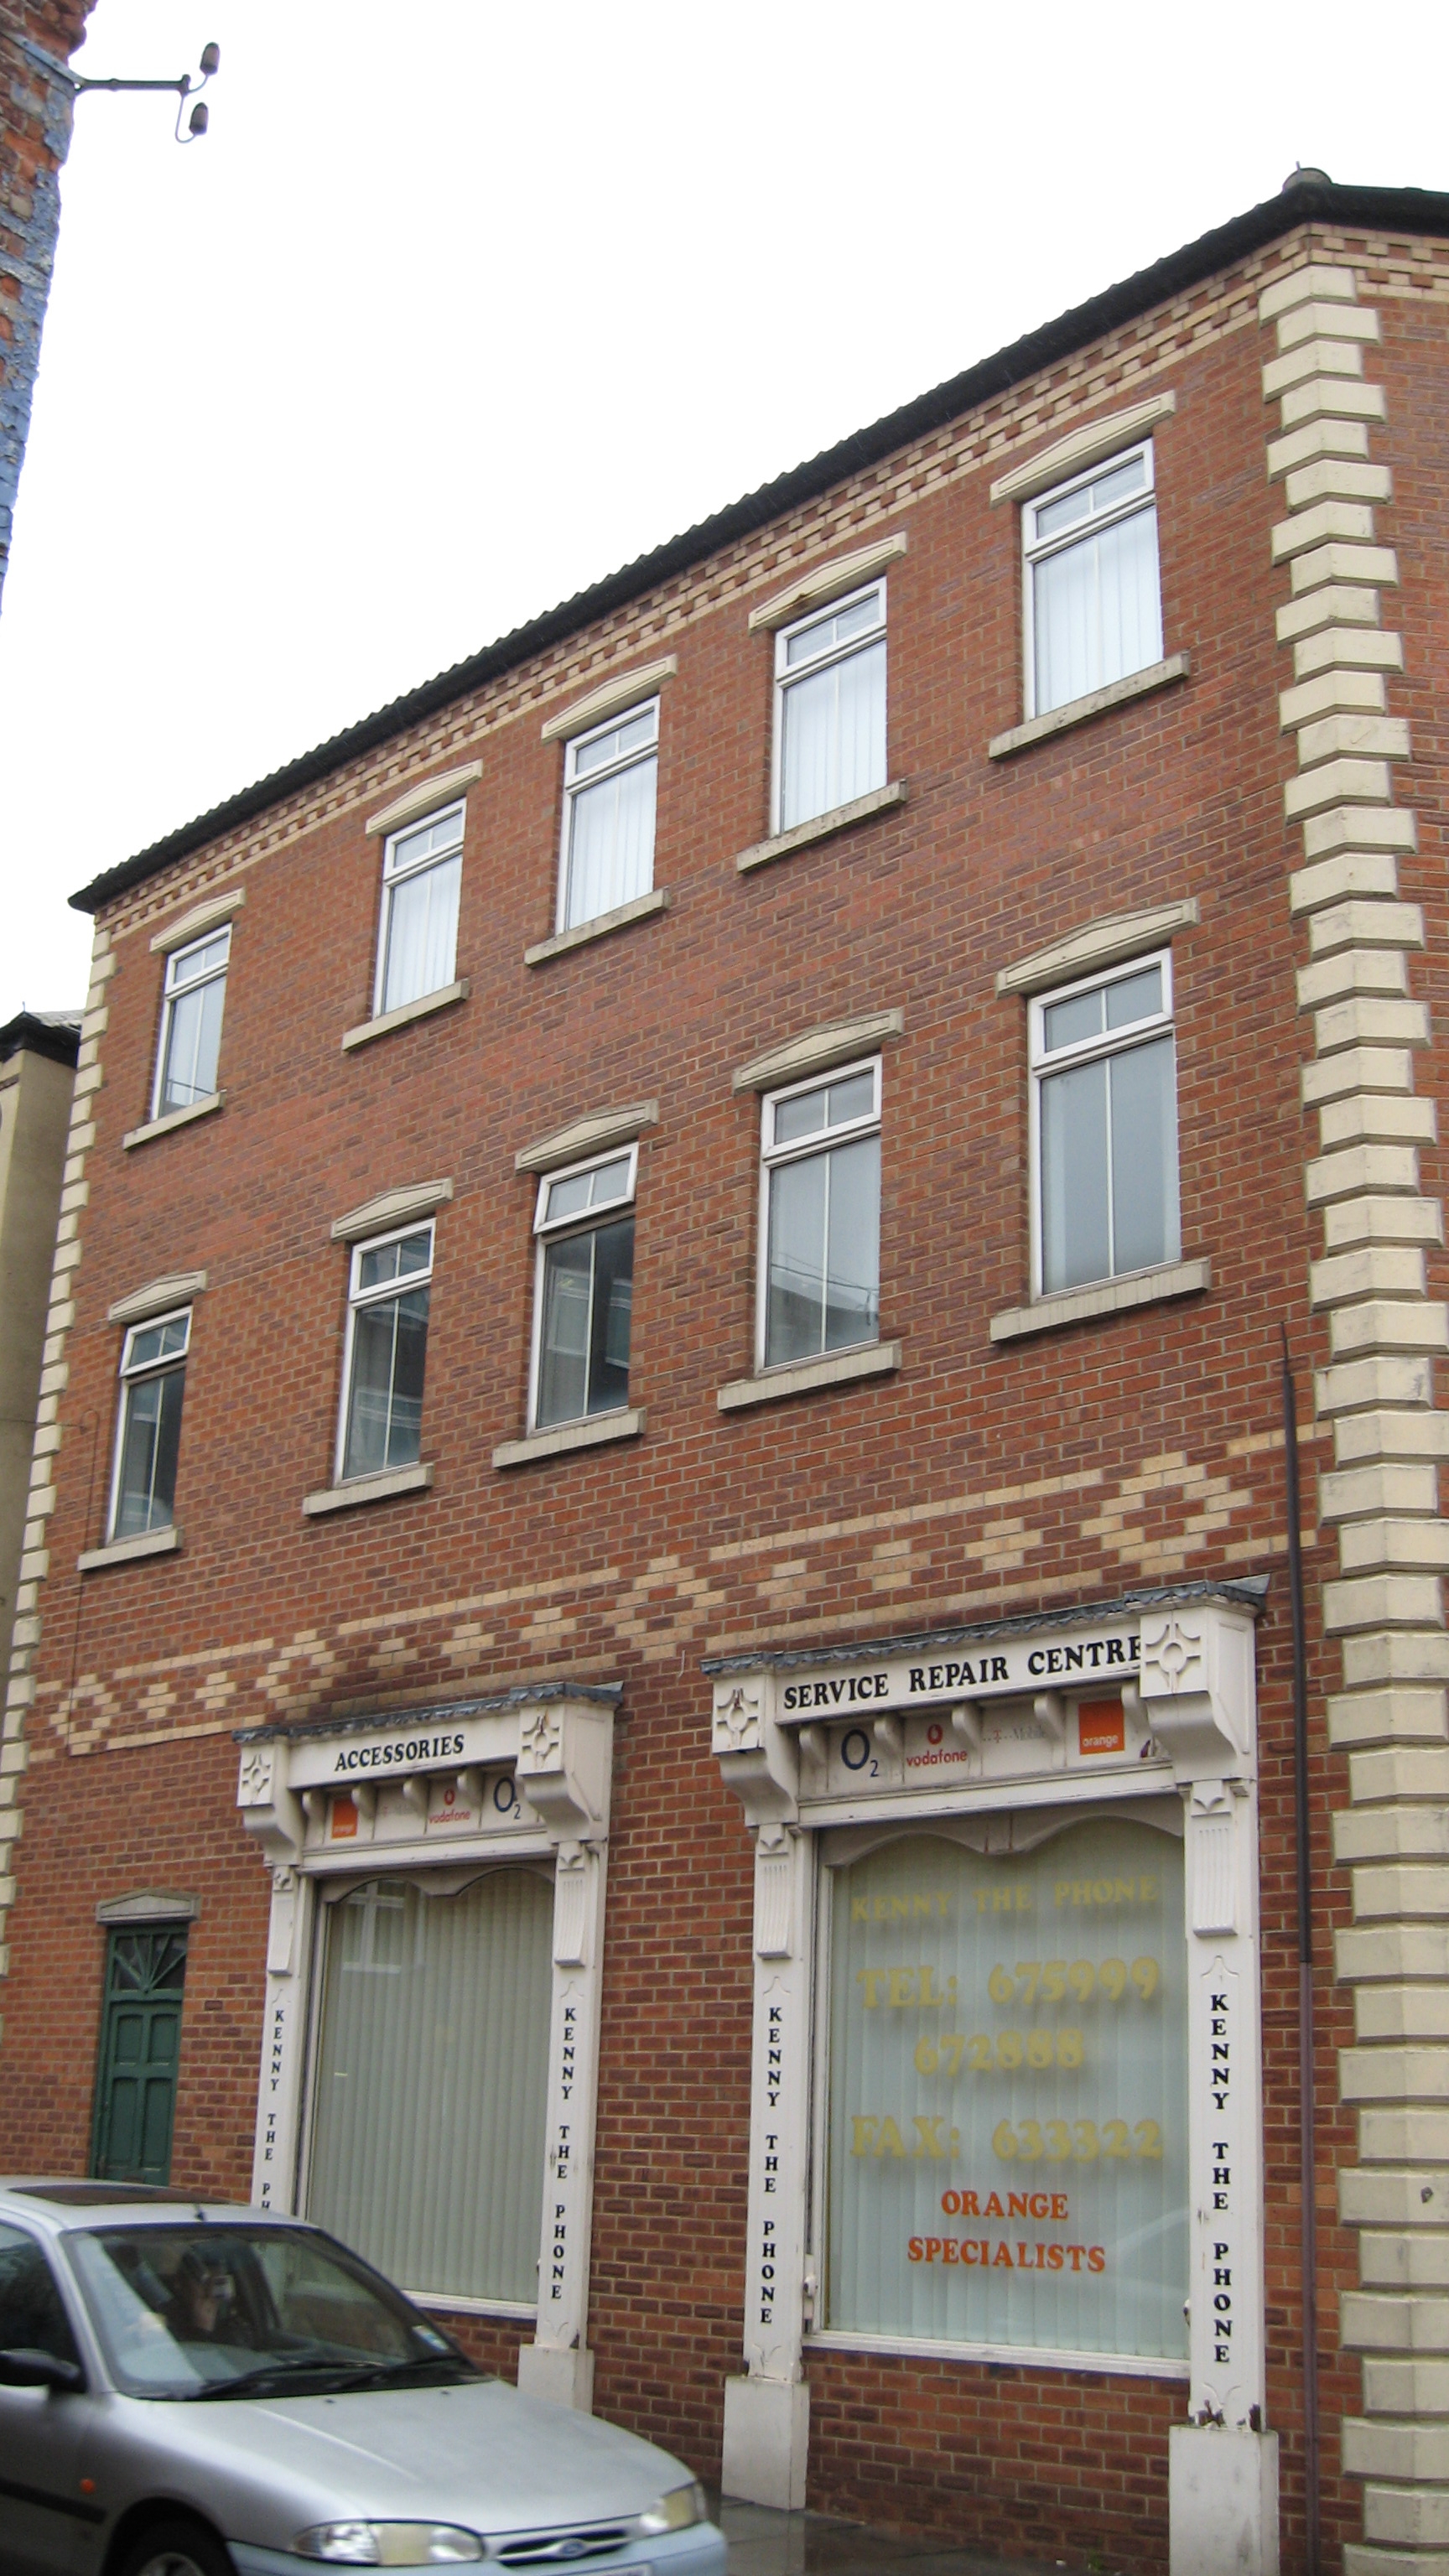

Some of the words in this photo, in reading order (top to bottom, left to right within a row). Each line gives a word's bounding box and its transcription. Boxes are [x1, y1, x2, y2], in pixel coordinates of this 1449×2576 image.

[784, 1673, 889, 1710] SERVICE
[909, 1656, 1010, 1692] REPAIR
[1028, 1635, 1140, 1675] CENTRE
[335, 1734, 465, 1772] ACCESSORIES
[906, 1748, 968, 1768] vodafone
[1082, 1734, 1119, 1748] orange
[428, 1809, 471, 1825] vodafone
[851, 1890, 953, 1923] KENNY
[972, 1886, 1033, 1914] THE
[1053, 1875, 1159, 1909] PHONE
[855, 1965, 958, 2009] TEL:
[987, 1955, 1160, 2005] 675999
[270, 2009, 284, 2092] KENNY
[560, 2007, 577, 2101] KENNY
[766, 2007, 782, 2108] KENNY
[913, 2028, 1085, 2077] 672888
[1210, 1993, 1230, 2111] KENNY
[264, 2112, 277, 2161] THE
[557, 2125, 570, 2179] THE
[849, 2115, 960, 2159] FAX:
[992, 2118, 1164, 2163] 633322
[764, 2135, 778, 2194] THE
[1212, 2142, 1231, 2211] THE
[941, 2189, 1068, 2220] ORANGE
[552, 2205, 566, 2300] PHONE
[760, 2220, 776, 2324] PHONE
[907, 2236, 1105, 2273] SPECIALISTS
[1213, 2242, 1233, 2364] PHONE
